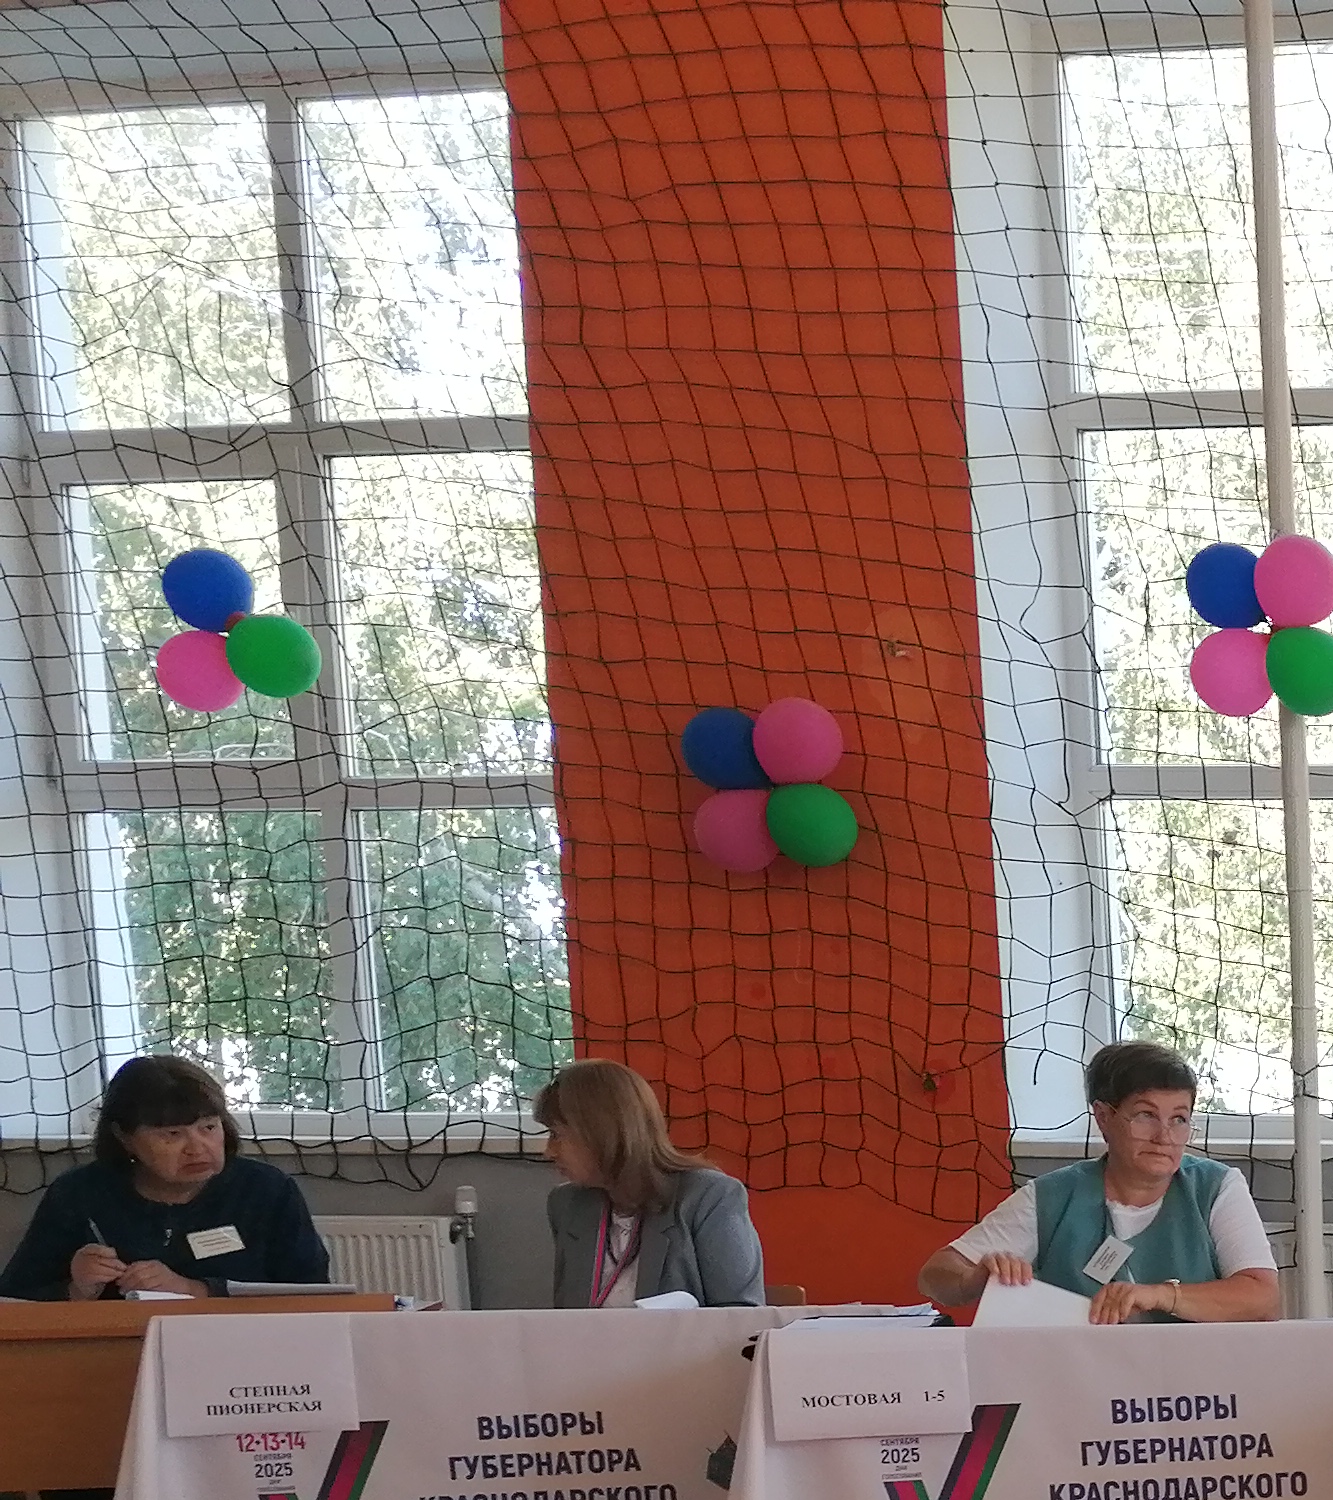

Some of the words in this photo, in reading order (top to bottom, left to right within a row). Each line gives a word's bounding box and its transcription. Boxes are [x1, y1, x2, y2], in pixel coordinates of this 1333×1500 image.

[229, 1384, 311, 1399] СТЕПНАЯ
[801, 1391, 902, 1408] МОСТОВАЯ
[923, 1389, 945, 1402] 1-5
[206, 1400, 322, 1416] ПИОНЕРСКАЯ
[1110, 1393, 1238, 1425] ВЫБОРЫ
[476, 1410, 605, 1441] ВЫБОРЫ
[880, 1447, 920, 1464] 2025
[1080, 1432, 1275, 1467] ГУБЕРНАТОРА
[254, 1462, 293, 1478] 2025
[448, 1447, 642, 1481] ГУБЕРНАТОРА
